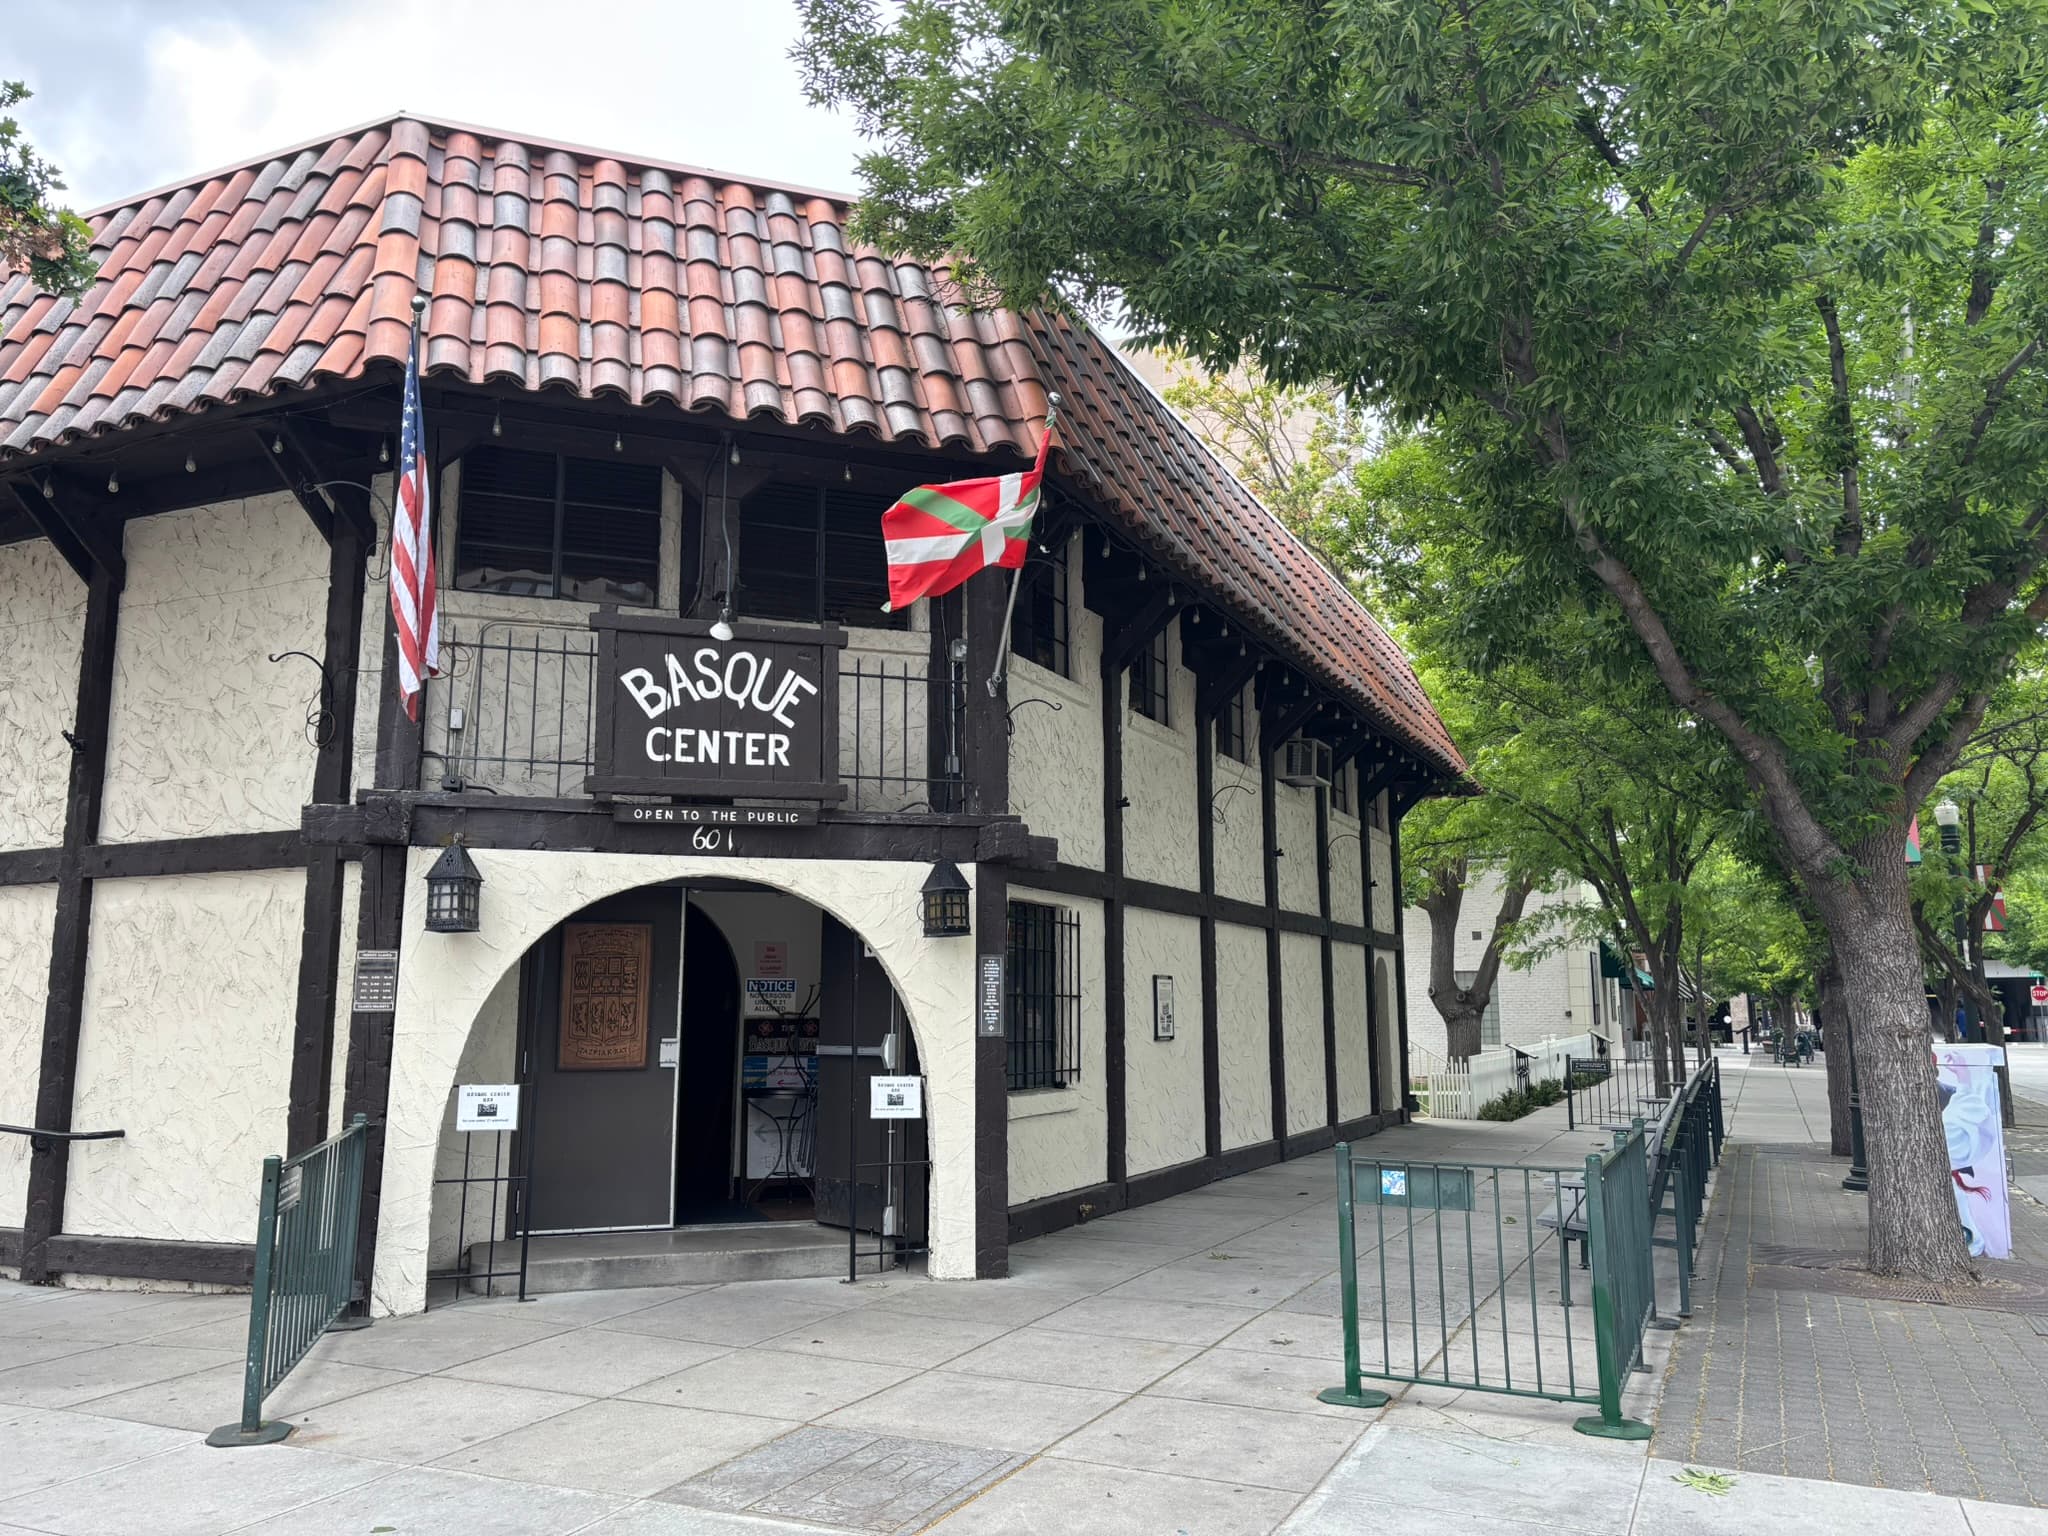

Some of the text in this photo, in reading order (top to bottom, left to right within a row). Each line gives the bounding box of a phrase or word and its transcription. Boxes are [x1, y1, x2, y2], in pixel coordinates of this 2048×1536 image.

[620, 648, 818, 728] BASQUE
[645, 726, 790, 767] CENTER
[633, 808, 799, 824] OPEN TO THE PUBLIC
[692, 825, 734, 852] 601
[748, 980, 793, 992] NOTICE
